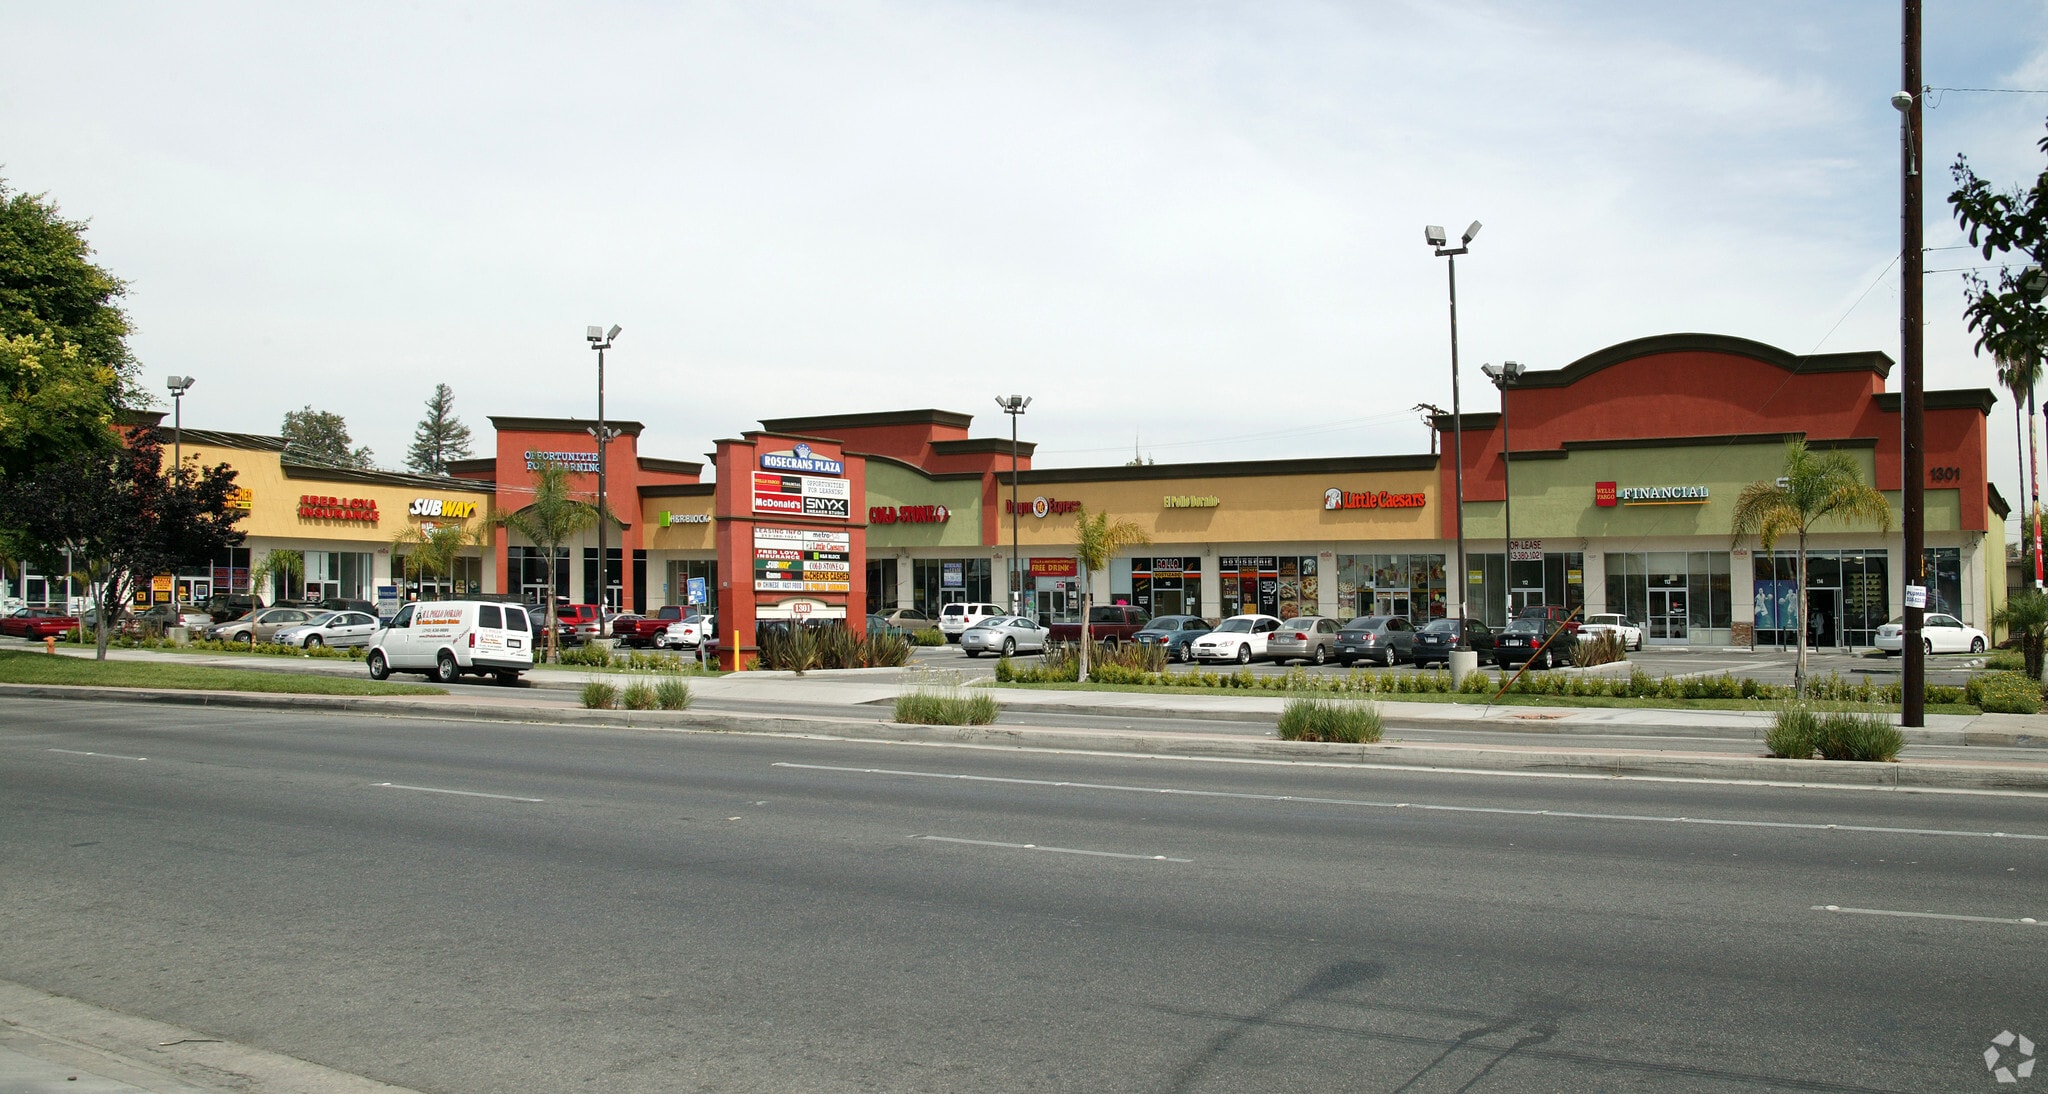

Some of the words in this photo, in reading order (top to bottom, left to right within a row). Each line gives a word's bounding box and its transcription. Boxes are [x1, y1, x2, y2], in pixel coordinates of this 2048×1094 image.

[524, 450, 599, 462] OPPORTUNITIE
[764, 456, 812, 470] ROSECRANS
[815, 461, 840, 472] PLAZA
[1930, 467, 1960, 482] 1301
[807, 480, 844, 488] OPPORTUNITIES
[1624, 486, 1709, 499] FINANCIAL
[301, 495, 338, 507] FRED
[343, 498, 377, 509] LOYA
[755, 498, 800, 509] McDonald's
[806, 498, 845, 510] SNYX
[1164, 496, 1171, 508] El
[1171, 496, 1190, 508] Pollo
[1190, 495, 1218, 507] Dorado
[1344, 492, 1377, 509] Little
[1378, 491, 1426, 508] Caesars
[299, 506, 380, 521] INSURANCE
[410, 499, 478, 518] SUBWAY
[1006, 499, 1032, 515] Dagon
[687, 514, 709, 523] BLOCK
[869, 506, 896, 525] COLD
[898, 505, 935, 524] STONE
[1510, 541, 1518, 550] OR
[1521, 540, 1542, 550] LEASE
[1510, 551, 1542, 560] 13-380-1021
